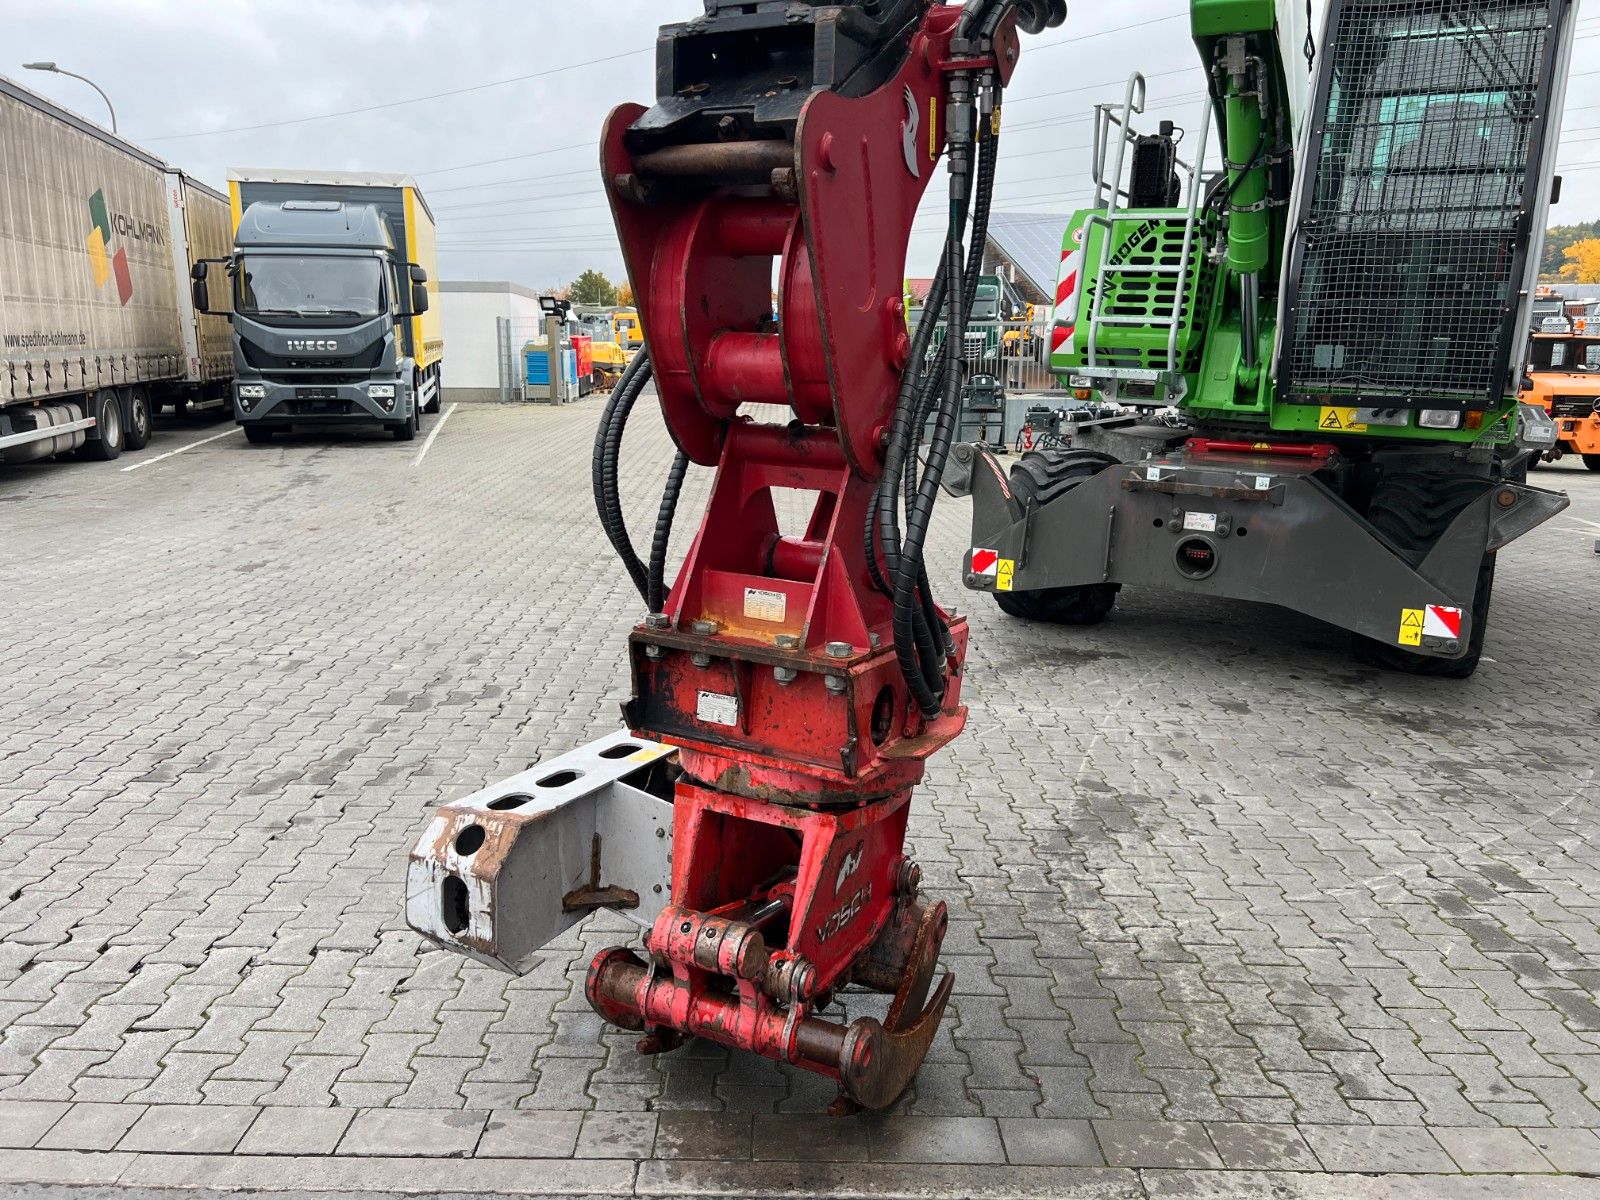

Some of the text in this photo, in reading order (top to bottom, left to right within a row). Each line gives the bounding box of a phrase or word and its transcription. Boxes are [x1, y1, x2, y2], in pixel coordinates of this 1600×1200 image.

[110, 211, 165, 246] KOHLMANN
[3, 329, 86, 351] www.spedition-kohlmann.de
[287, 340, 338, 351] IVECO
